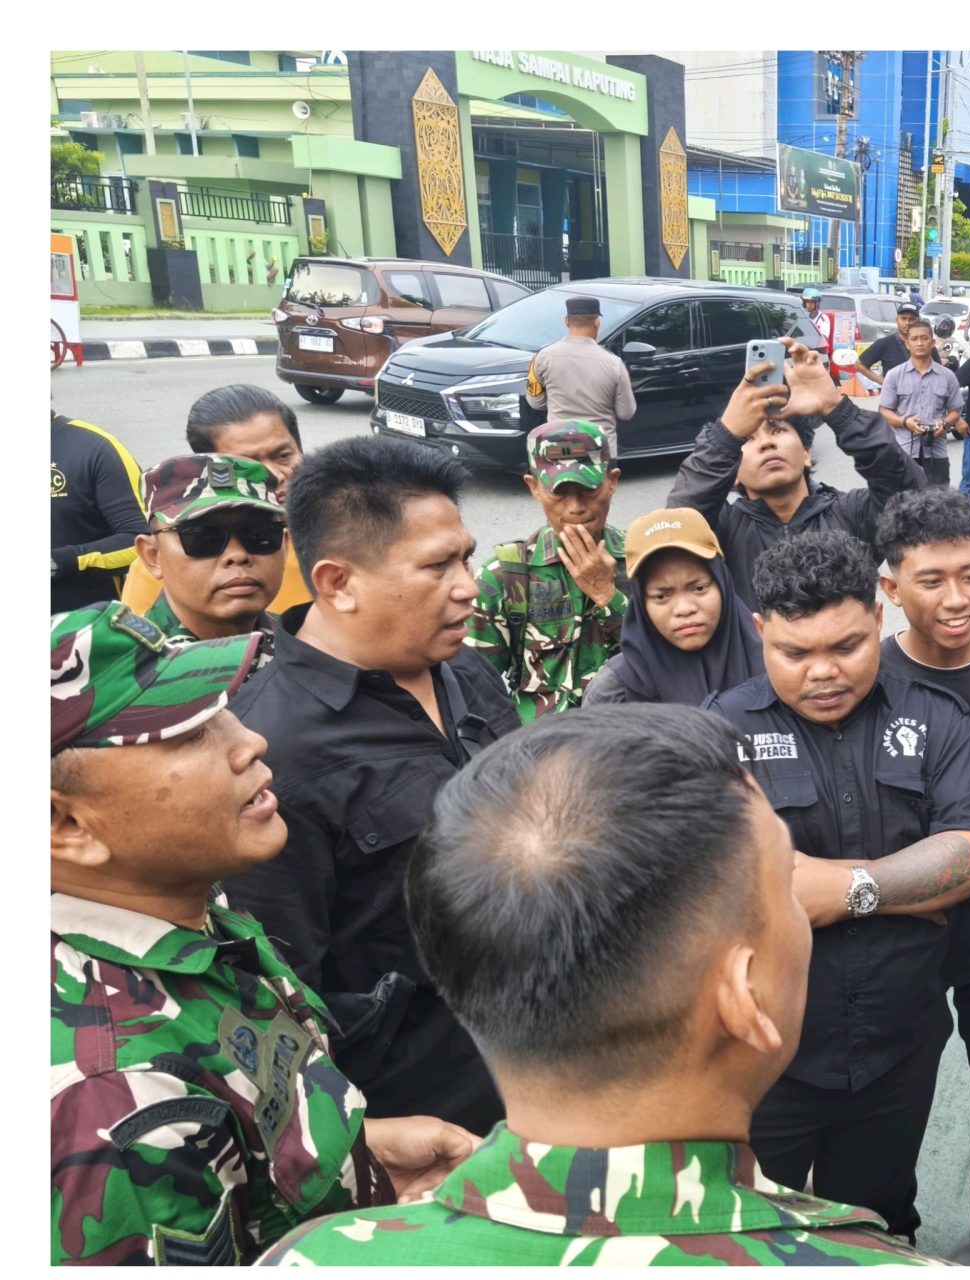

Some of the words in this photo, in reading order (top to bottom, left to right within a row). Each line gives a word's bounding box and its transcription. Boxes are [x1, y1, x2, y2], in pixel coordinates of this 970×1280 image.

[518, 52, 571, 84] SAMPAI
[572, 66, 636, 101] KAPUTING
[753, 733, 796, 745] JUSTICE
[882, 730, 898, 757] BLACK
[760, 746, 793, 758] PEACE
